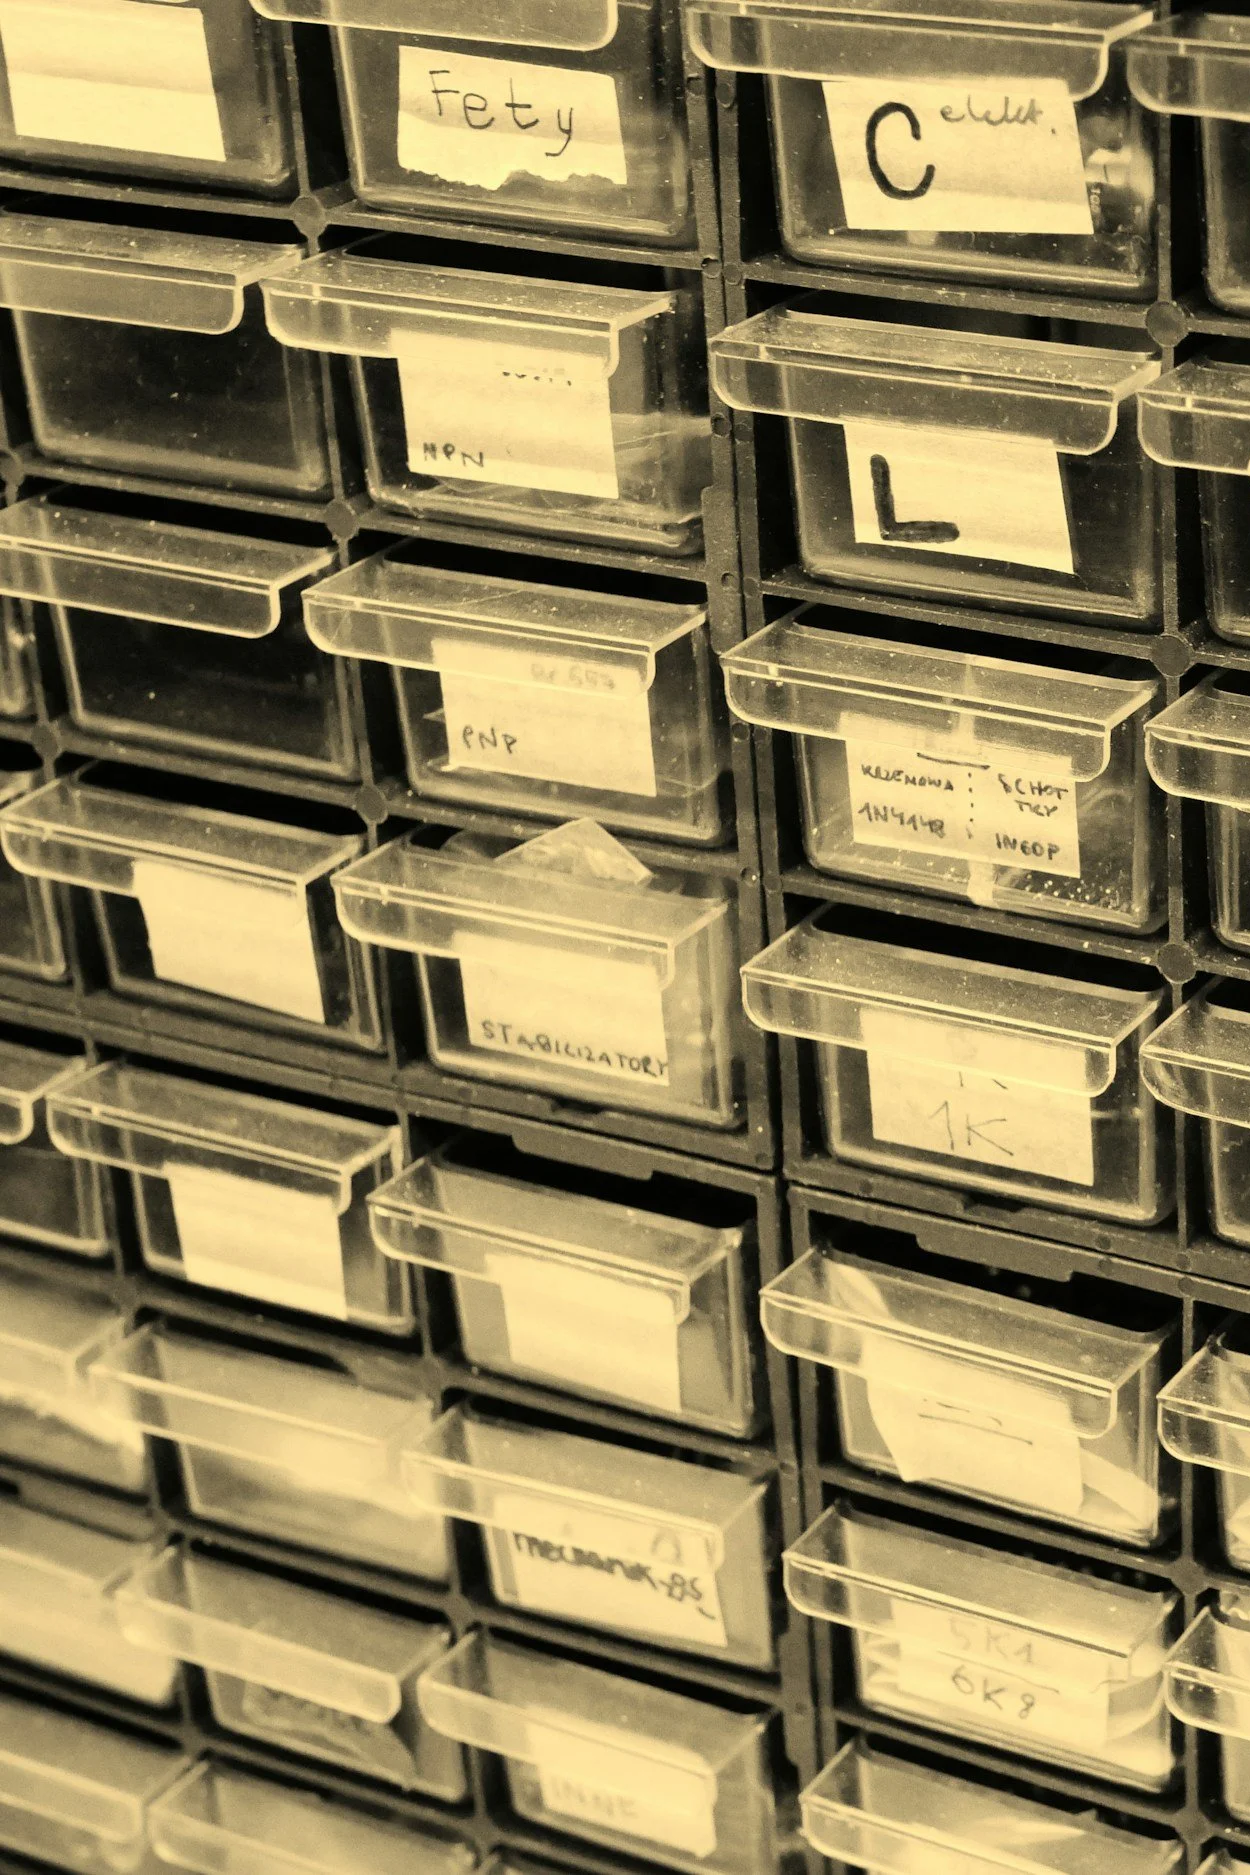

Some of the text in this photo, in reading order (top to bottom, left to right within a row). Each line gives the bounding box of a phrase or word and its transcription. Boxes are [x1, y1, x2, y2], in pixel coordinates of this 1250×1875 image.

[428, 69, 574, 157] Fety
[866, 101, 936, 200] C
[870, 454, 960, 543] L
[463, 724, 518, 754] PNP
[928, 1100, 1014, 1156] 1K
[951, 1664, 1037, 1720] 6K8
